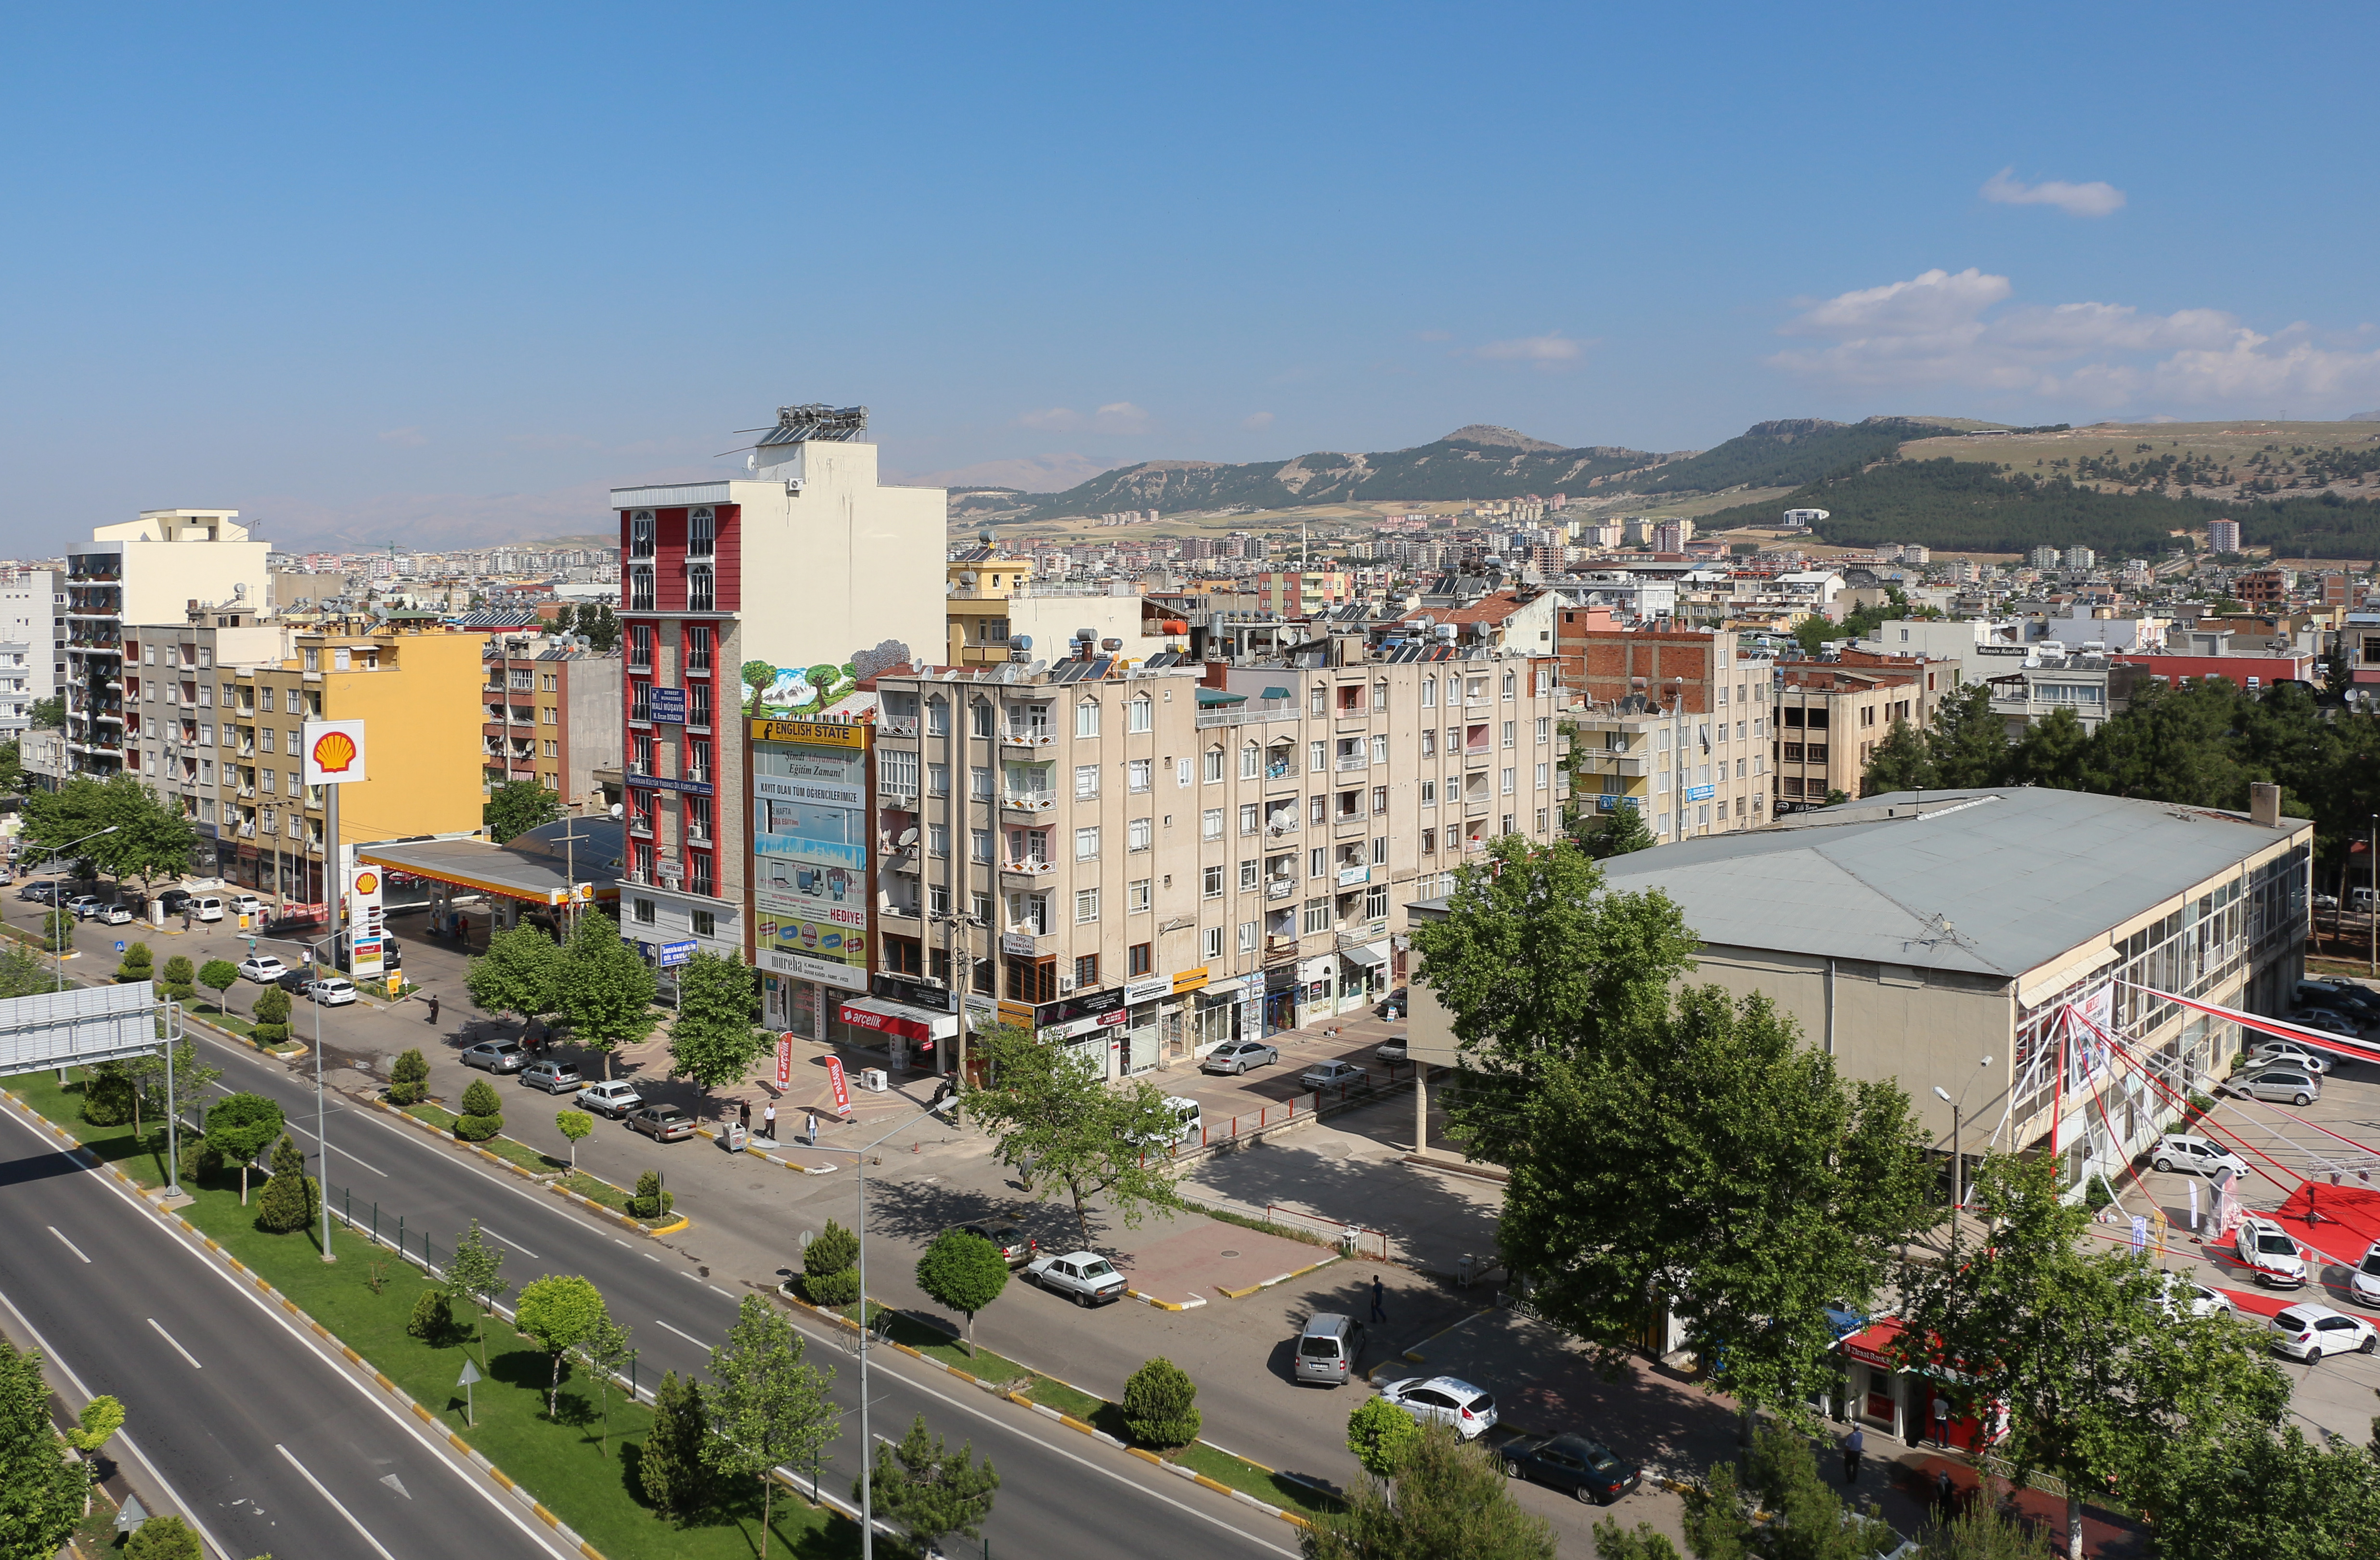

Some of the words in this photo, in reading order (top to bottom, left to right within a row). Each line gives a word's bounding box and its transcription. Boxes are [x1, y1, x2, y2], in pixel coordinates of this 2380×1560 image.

[652, 702, 662, 710] MALİ
[663, 702, 684, 713] MÜŞAVİR
[776, 723, 811, 736] ENGLISH
[815, 726, 849, 739] STATE
[789, 764, 811, 776] Eğitim
[761, 782, 776, 793] KAYIT
[777, 784, 791, 795] OLAN
[793, 785, 805, 797] TÜM
[806, 786, 857, 803] ÖĞRENCİLERİMİZE
[1270, 881, 1291, 892] AVUKAT
[830, 908, 863, 925] HEDİYE!
[803, 928, 815, 936] GENEL
[771, 955, 802, 973] mureba
[853, 1013, 881, 1027] arçelik
[780, 1040, 789, 1070] arçelik
[1851, 1347, 1869, 1359] Ziraat
